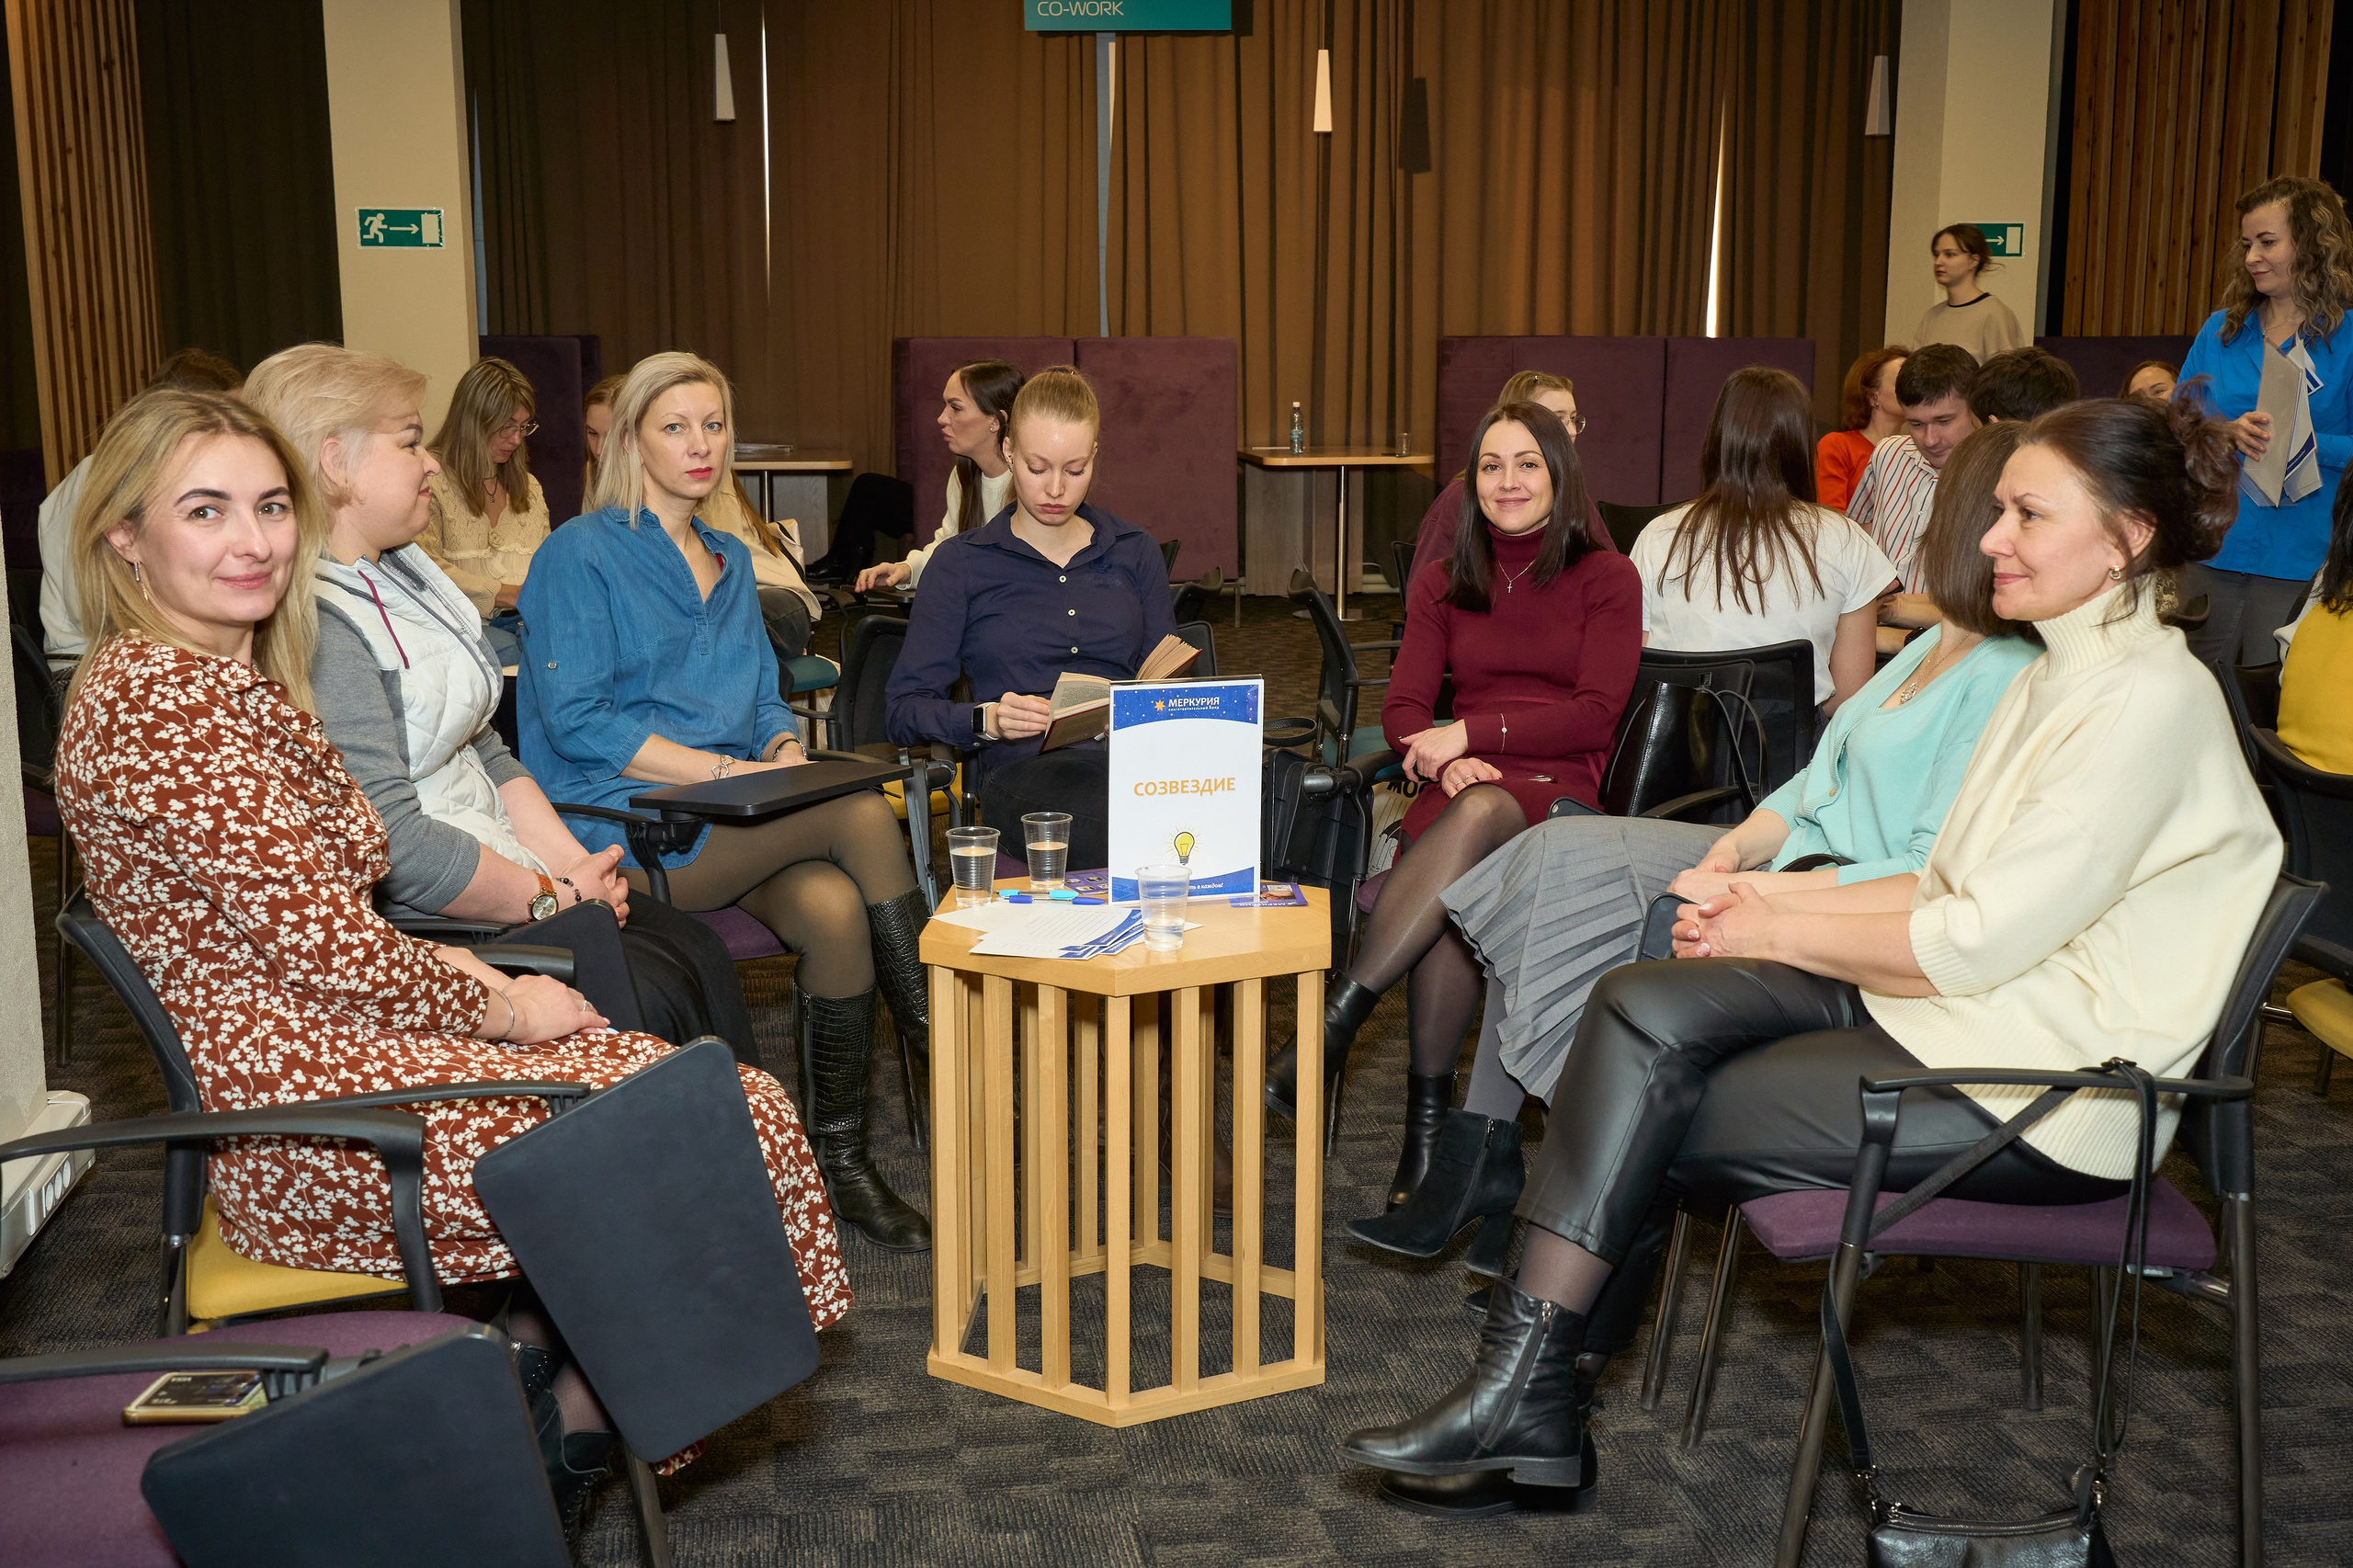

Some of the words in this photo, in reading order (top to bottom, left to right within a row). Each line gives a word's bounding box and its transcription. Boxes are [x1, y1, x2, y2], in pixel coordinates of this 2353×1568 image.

[1037, 1, 1124, 17] CO-WORK
[1168, 697, 1220, 708] МЕРКУРИЯ
[1133, 777, 1236, 797] СОЗВЕЗДИЕ
